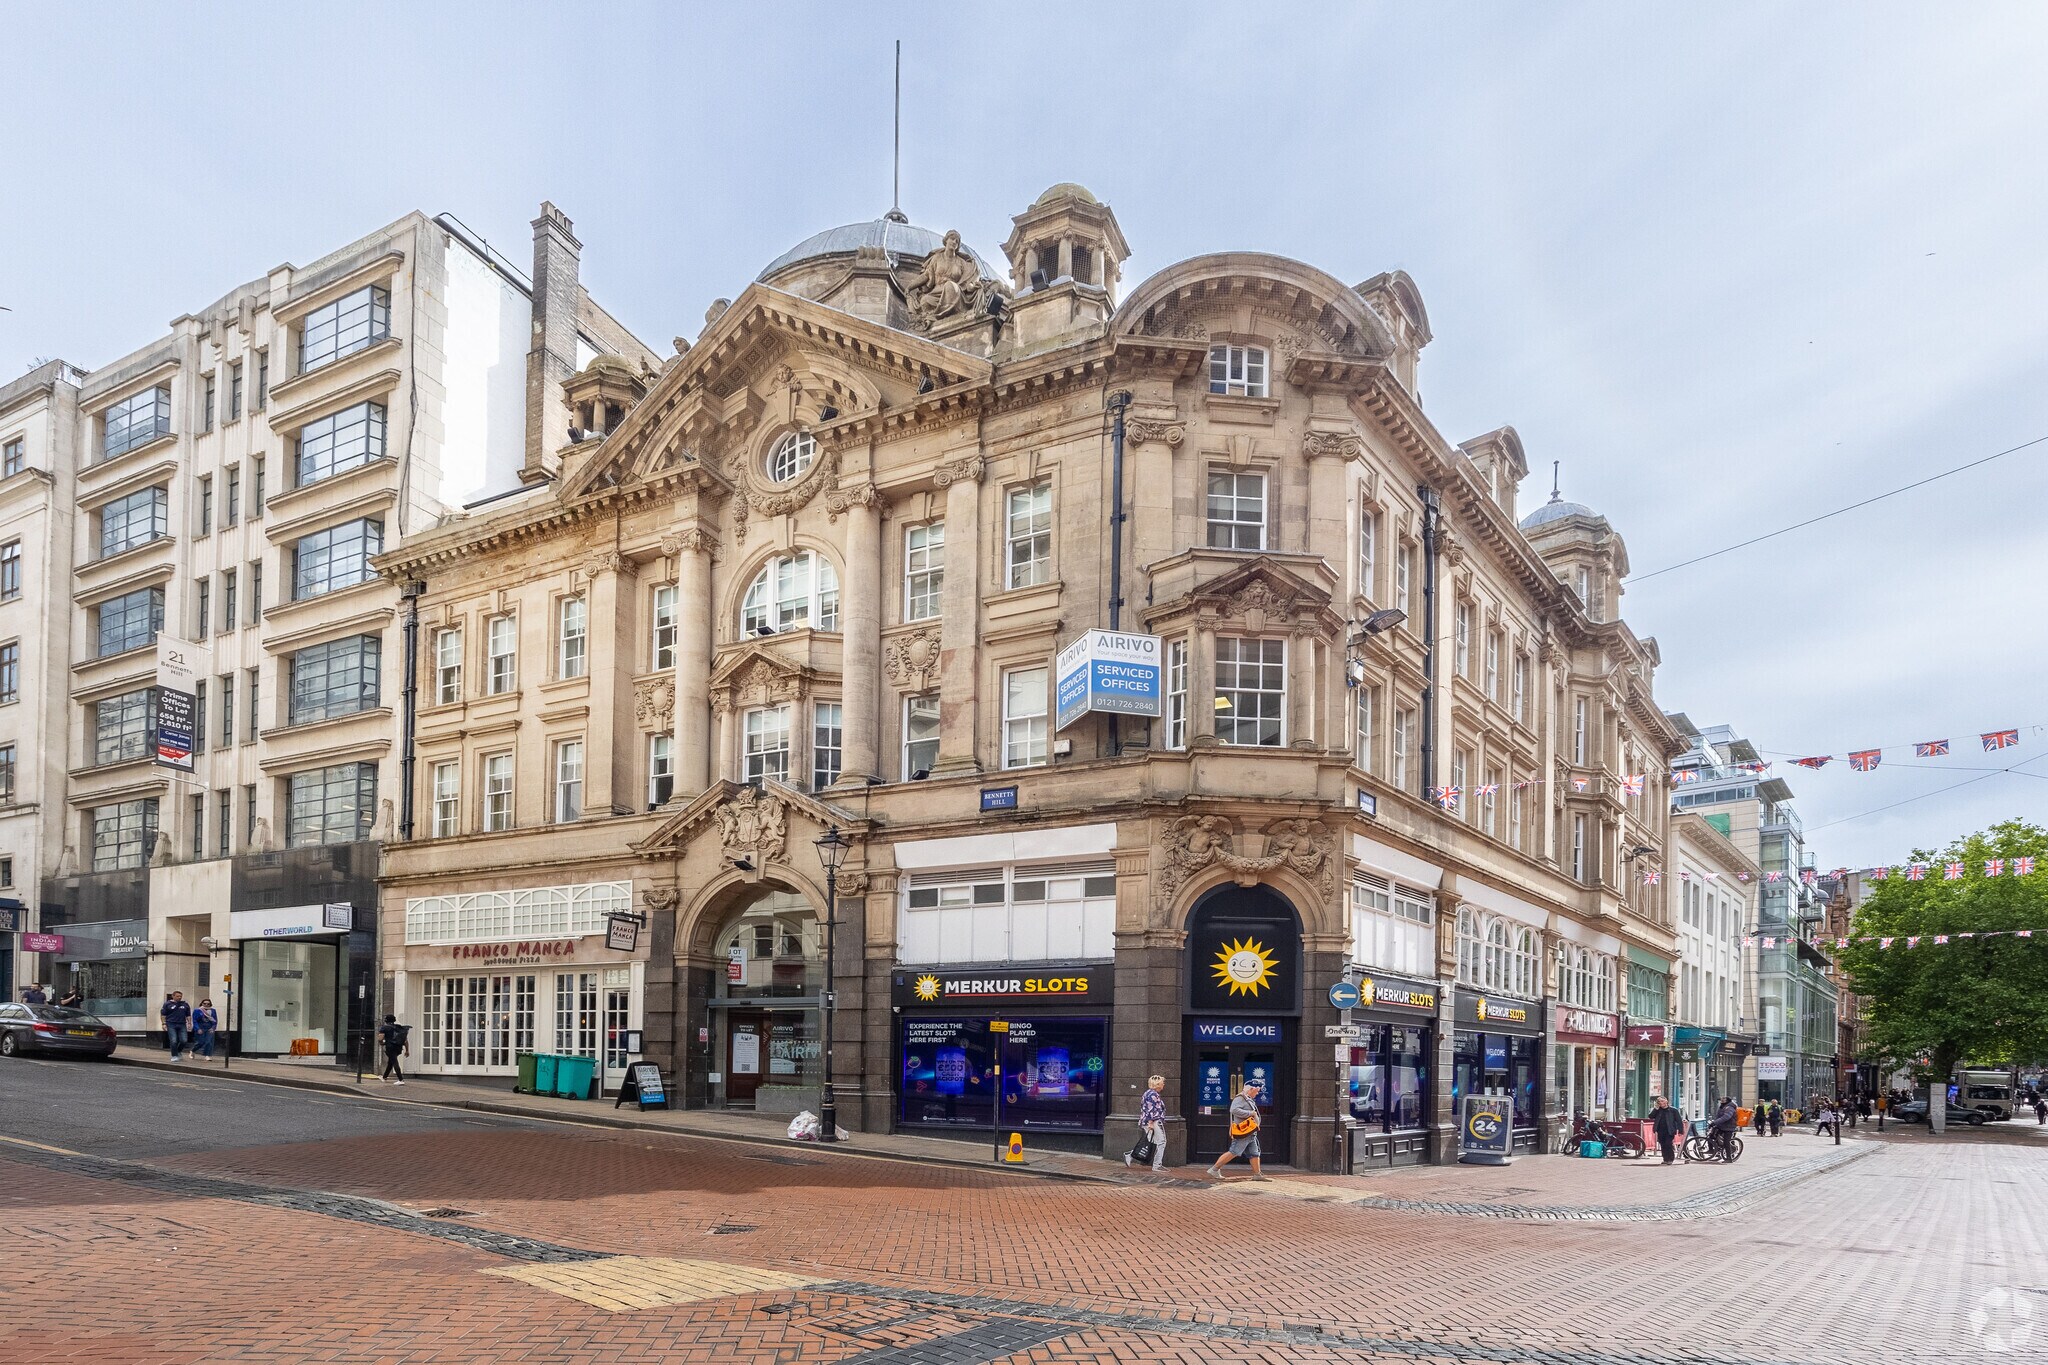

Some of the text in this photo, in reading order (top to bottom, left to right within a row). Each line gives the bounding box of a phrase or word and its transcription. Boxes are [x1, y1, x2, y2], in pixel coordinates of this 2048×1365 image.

[1097, 635, 1154, 652] AIRIVO
[168, 650, 186, 665] 21
[1060, 638, 1088, 669] AIRIVO
[1097, 664, 1154, 679] SERVICED
[1060, 668, 1087, 694] SERVICED
[1101, 678, 1150, 692] OFFICES
[164, 690, 188, 702] Prime
[1061, 682, 1086, 705] OFFICES
[162, 696, 191, 709] Offices
[1096, 698, 1154, 710] 0121 726 2840
[160, 712, 174, 720] 658
[175, 707, 188, 715] Let
[984, 792, 1014, 800] BENNETTS
[264, 926, 312, 936] OTHERWORLD
[612, 926, 634, 934] FRANCO
[612, 932, 632, 940] MANCA
[110, 936, 140, 947] INDIAN
[452, 940, 574, 959] FRANCO MANCA
[520, 956, 540, 964] PIZZA
[944, 978, 1089, 994] MERKUR SLOTS
[1376, 987, 1434, 1007] MERKUR SLOTS
[1487, 1005, 1526, 1020] MERKUR SLOTS
[1200, 1024, 1276, 1036] WELCOME
[782, 1046, 818, 1058] AIRIV
[1486, 1048, 1505, 1056] WELCOME
[1475, 1120, 1497, 1132] 24
